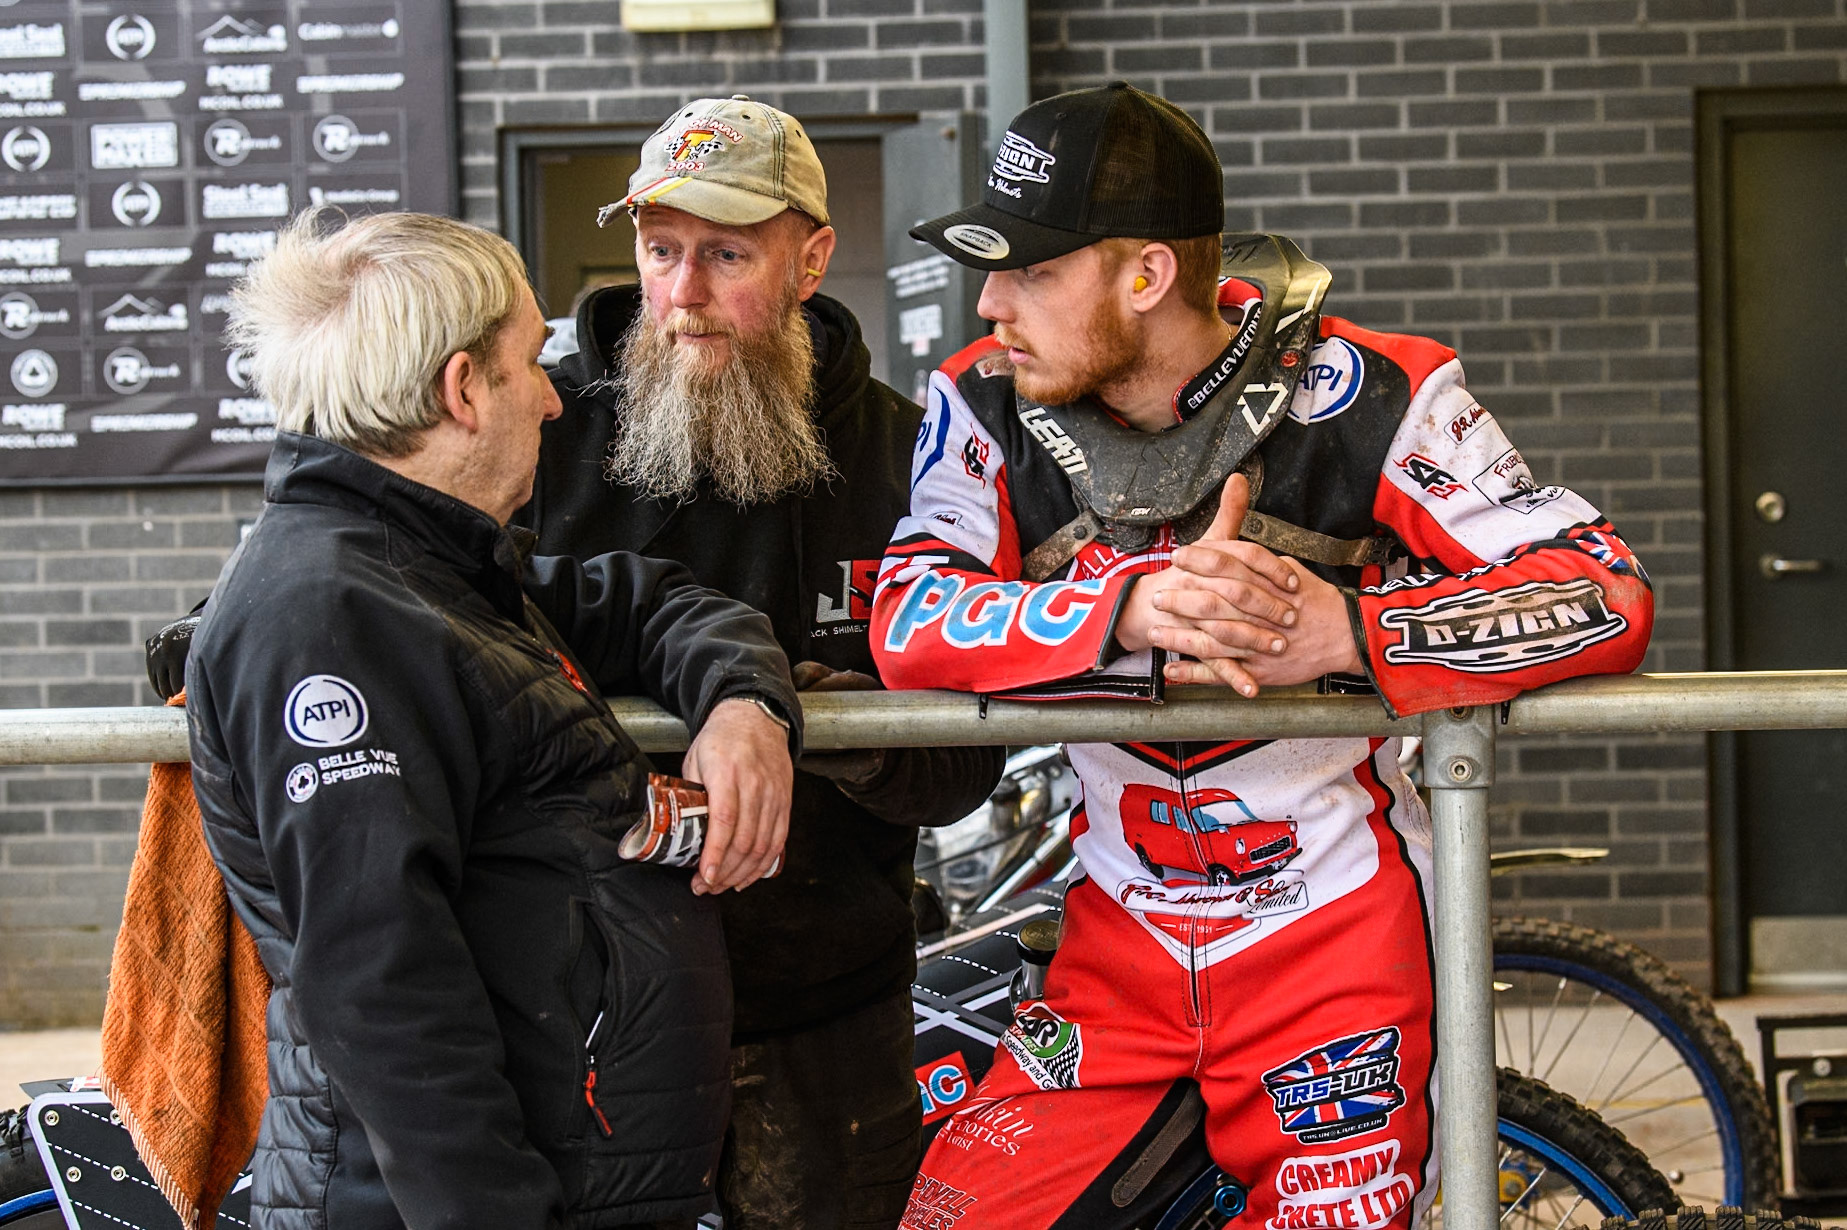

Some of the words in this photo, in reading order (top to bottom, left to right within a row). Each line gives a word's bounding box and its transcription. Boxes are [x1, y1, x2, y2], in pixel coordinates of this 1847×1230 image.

[708, 118, 744, 143] MAN
[664, 161, 704, 172] 2003
[885, 570, 1107, 653] PGC
[1423, 602, 1591, 647] D-ZIGN
[303, 699, 351, 727] ATPI
[318, 750, 367, 771] BELLE
[369, 748, 399, 765] VUE
[1009, 1025, 1041, 1053] SPARES
[1029, 1066, 1047, 1081] and
[1274, 1062, 1394, 1109] TRS-UK
[1281, 1147, 1394, 1195] CREAMY
[1360, 1181, 1410, 1225] LTD
